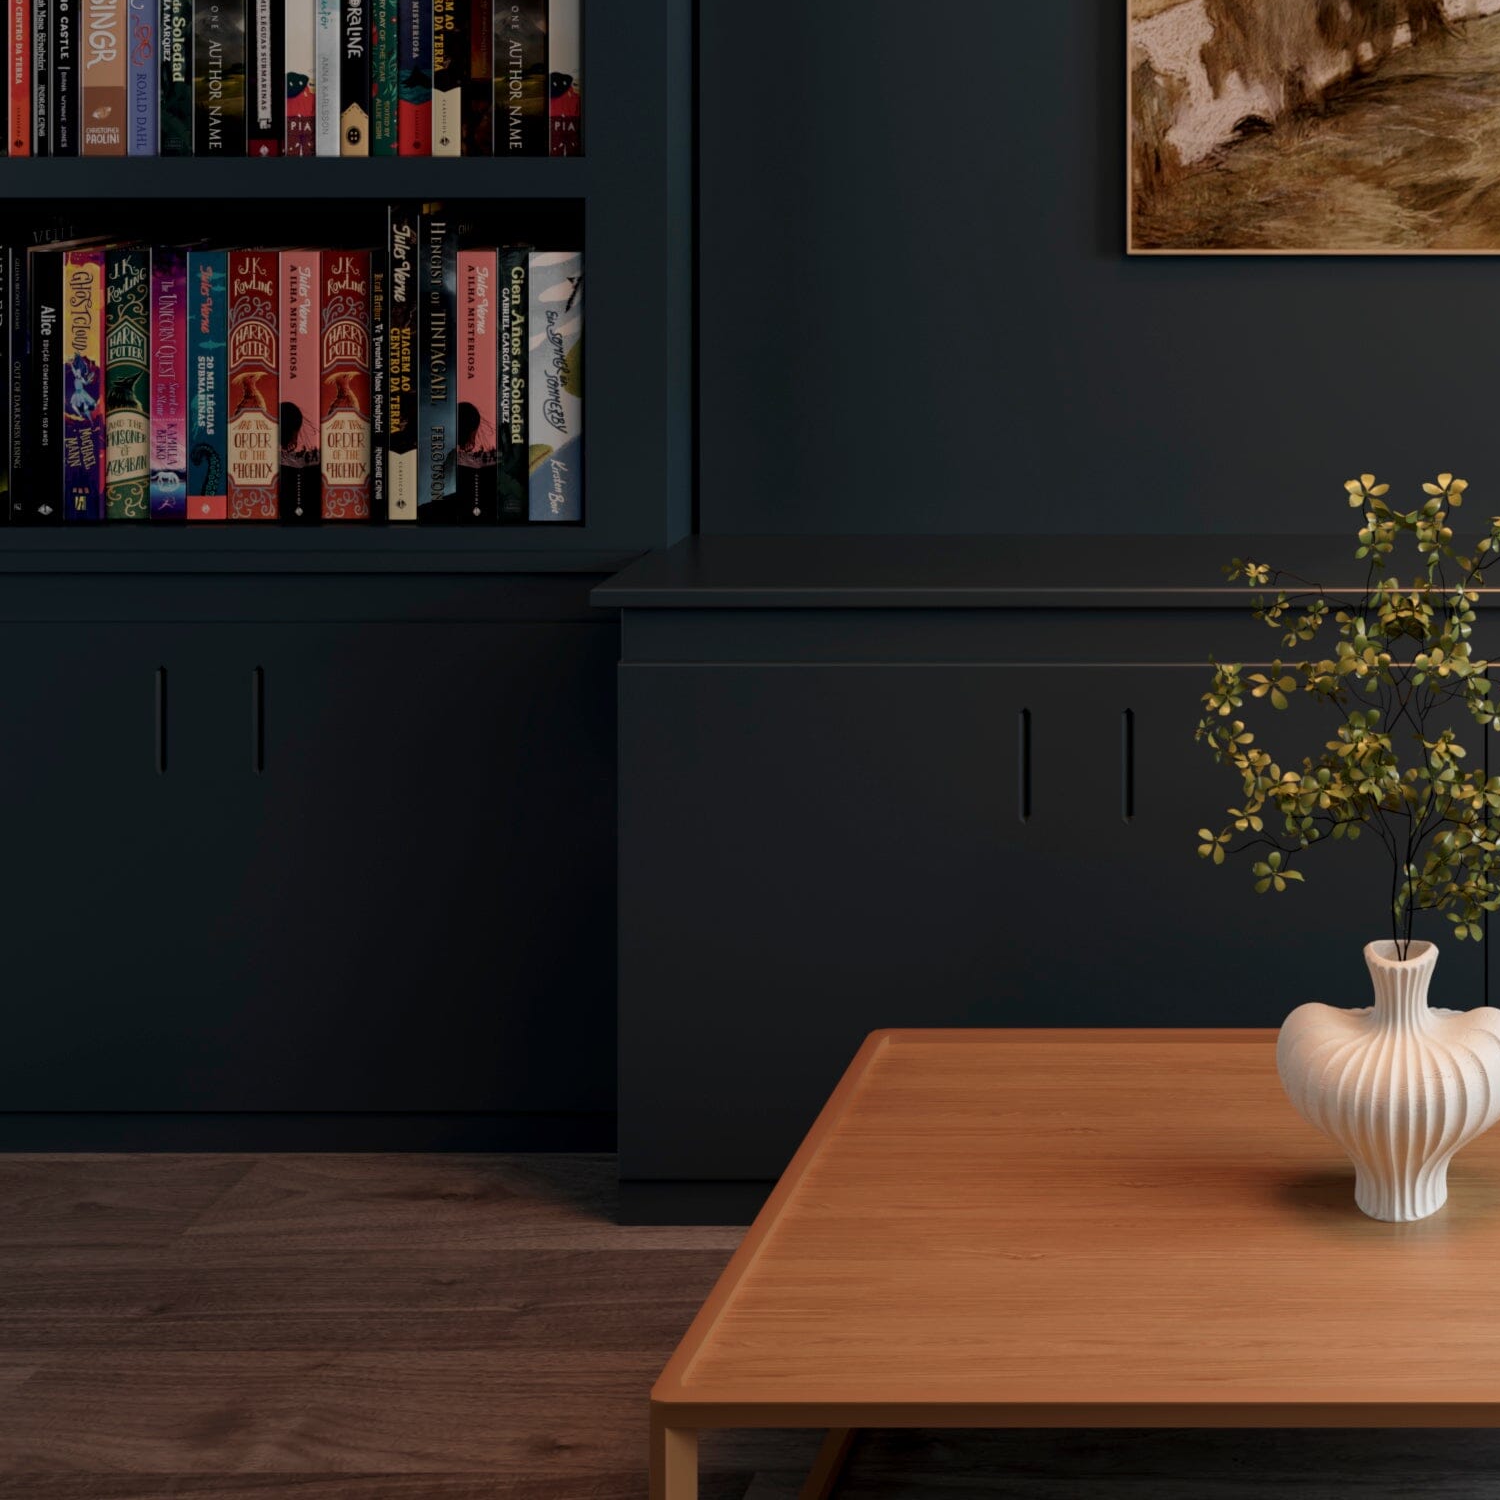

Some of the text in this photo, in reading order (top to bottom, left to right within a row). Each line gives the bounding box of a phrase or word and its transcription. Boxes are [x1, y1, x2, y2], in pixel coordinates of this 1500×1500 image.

[15, 7, 24, 38] CENTRO
[60, 17, 69, 59] CASTLE
[434, 17, 444, 31] DA
[445, 14, 454, 30] AO
[15, 43, 23, 54] DA
[434, 34, 444, 72] TERRA
[15, 57, 23, 84] TERRA
[136, 73, 148, 149] ROALD DAHL
[208, 40, 222, 149] AUTHOR NAME
[321, 57, 330, 135] ANNA KARLSSON
[509, 40, 522, 149] AUTHOR NAME
[393, 224, 409, 303] Jules Verne
[299, 266, 311, 334] Jules Verne
[467, 276, 475, 303] ILHA
[476, 266, 488, 334] Jules Verne
[108, 326, 145, 348] HARRY
[236, 324, 271, 343] HARRY
[467, 308, 475, 379] MISTERIOSA
[110, 346, 143, 360] POTTER
[401, 328, 410, 392] VIAGEM AO
[198, 356, 206, 427] SUBMARINAS
[206, 356, 217, 435] 20 MIL LÉGUAS
[390, 328, 400, 433] CENTRO DA TERRA
[65, 438, 81, 467] MANN
[234, 432, 271, 449] ORDER
[328, 432, 365, 449] ORDER
[233, 462, 273, 478] PHOENIX
[326, 462, 366, 479] PHOENIX
[432, 425, 445, 502] FERGUSON
